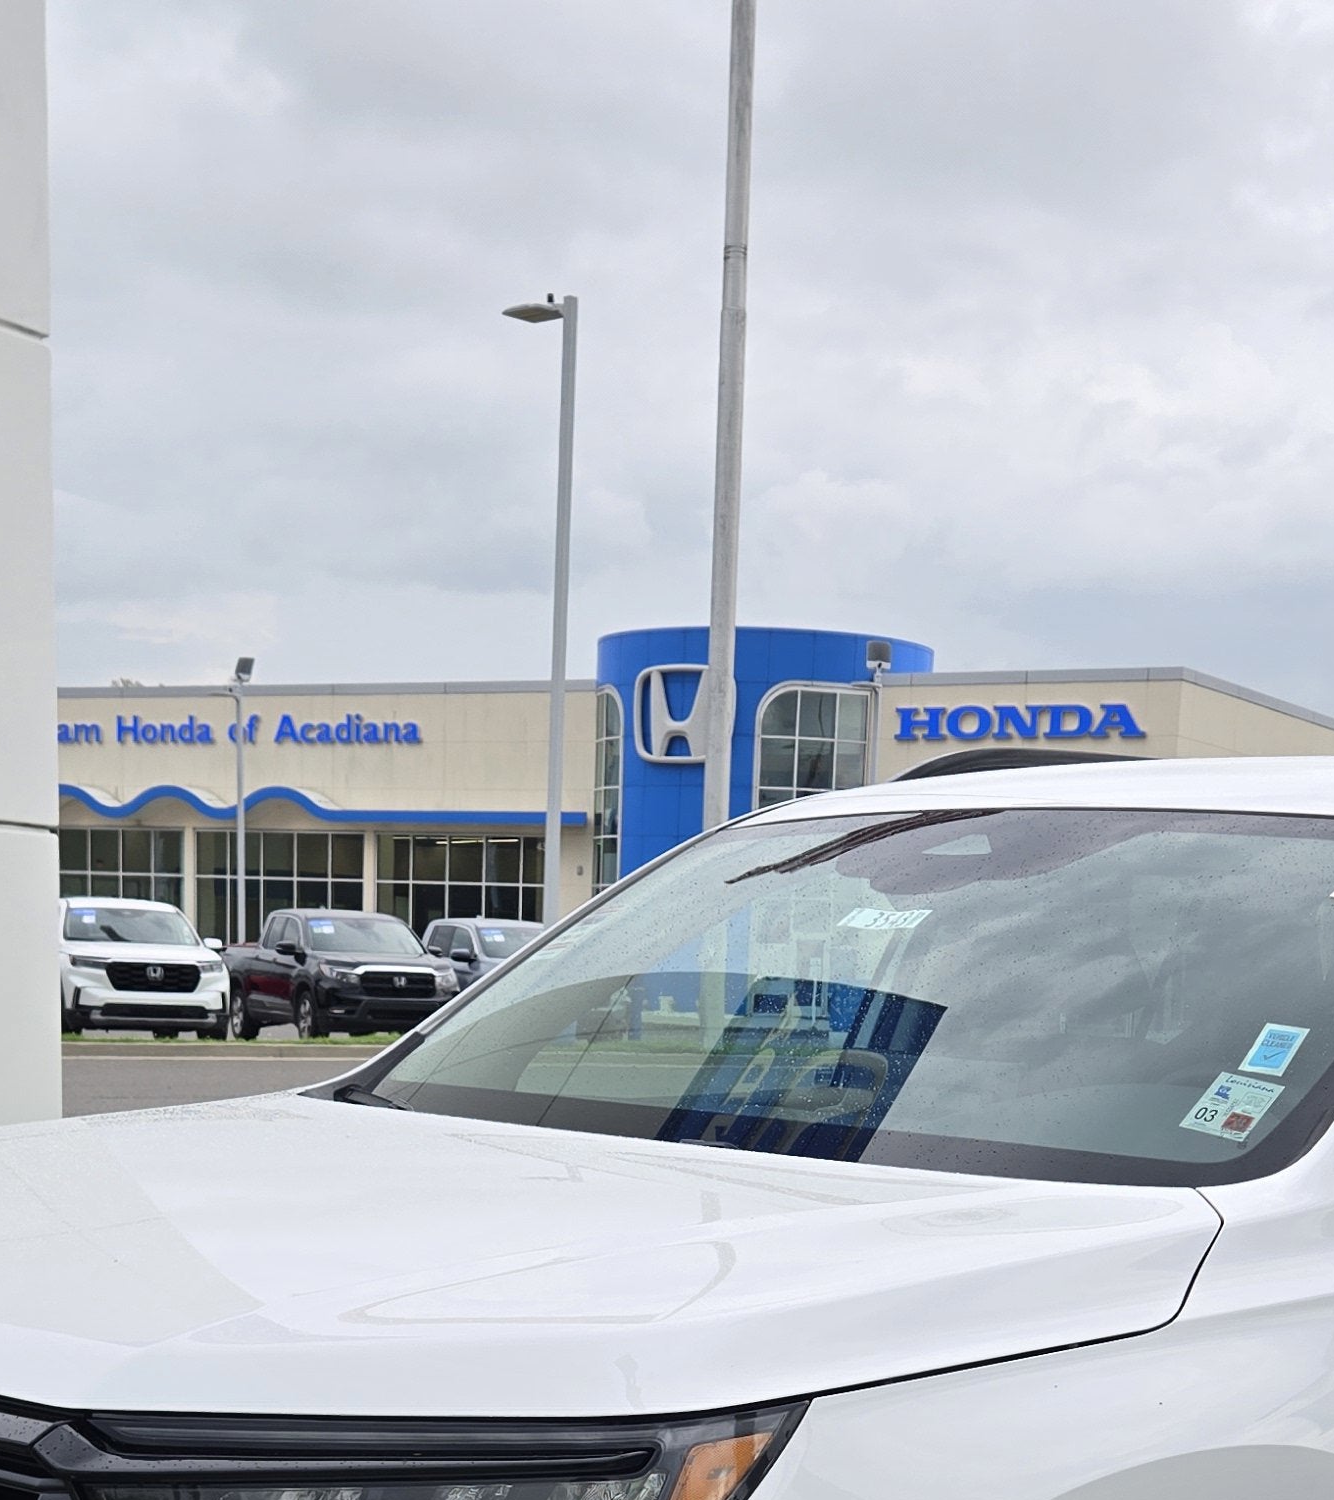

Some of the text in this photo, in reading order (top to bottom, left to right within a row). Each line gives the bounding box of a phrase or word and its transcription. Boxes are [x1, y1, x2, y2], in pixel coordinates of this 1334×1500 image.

[117, 715, 212, 744] Honda
[228, 714, 260, 743] of
[275, 714, 421, 743] Acadiana
[894, 703, 1146, 740] HONDA
[1225, 1075, 1275, 1093] Louisiana
[1195, 1108, 1218, 1123] 03
